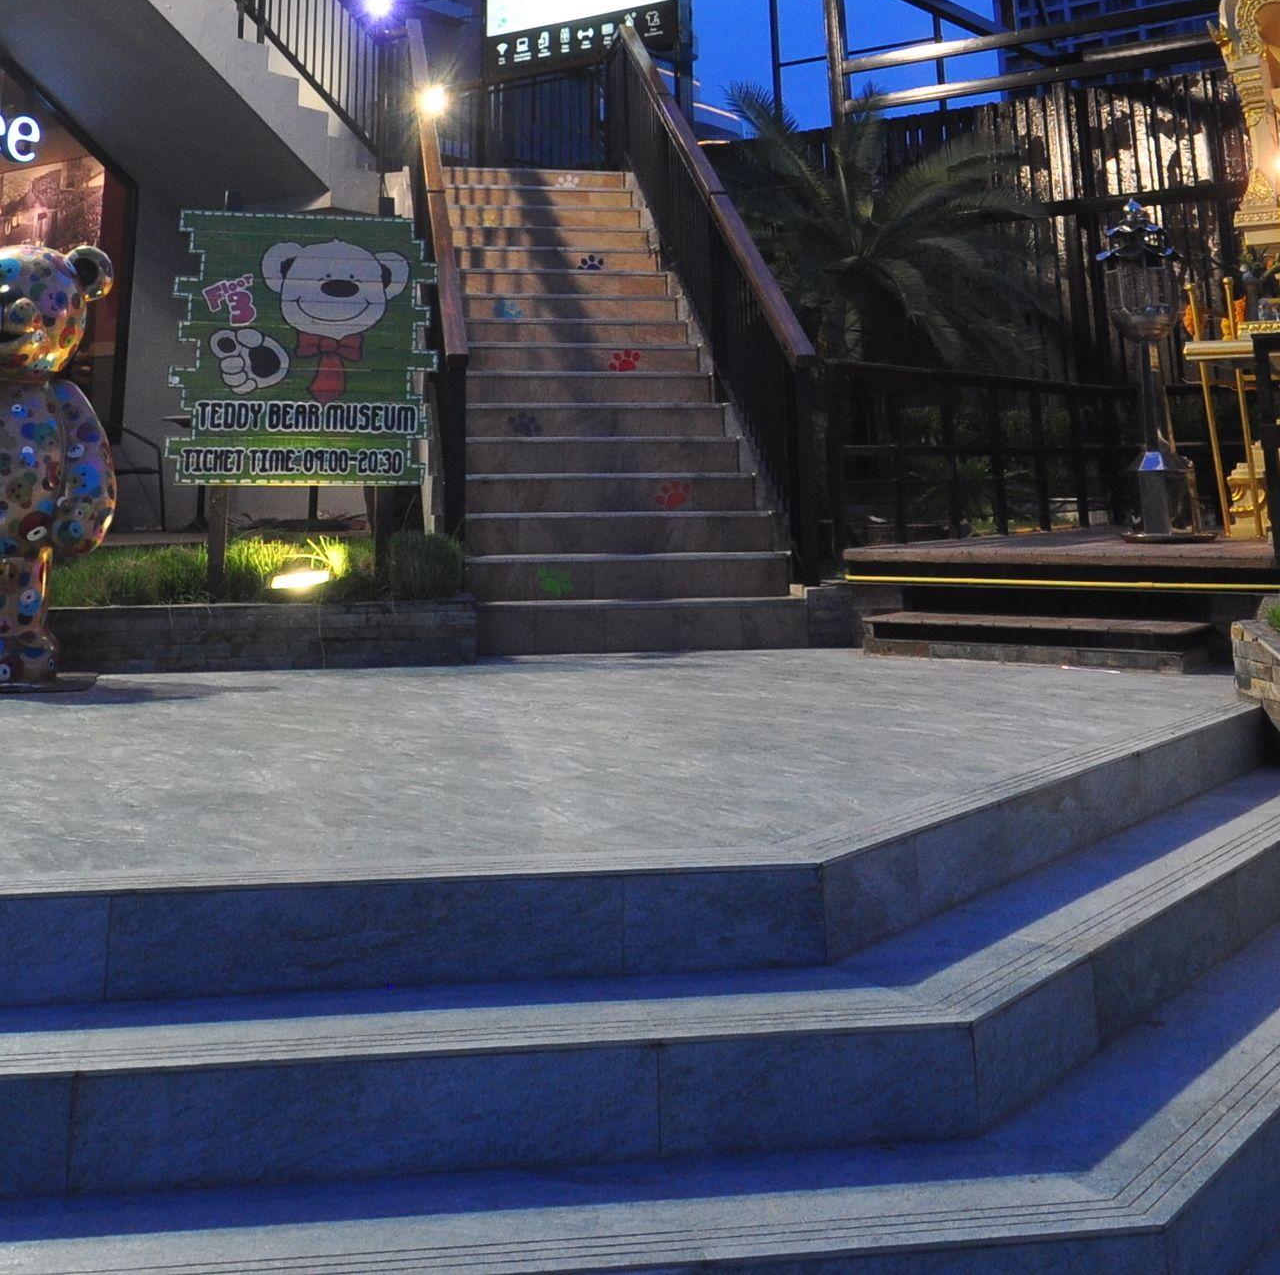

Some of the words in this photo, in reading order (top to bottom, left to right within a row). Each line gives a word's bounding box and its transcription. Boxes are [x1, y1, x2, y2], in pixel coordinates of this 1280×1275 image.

[202, 273, 254, 313] Floor
[228, 289, 257, 326] 3
[196, 401, 264, 431] TEDDY
[266, 401, 322, 432] BEAR
[323, 403, 418, 434] MUSEUM
